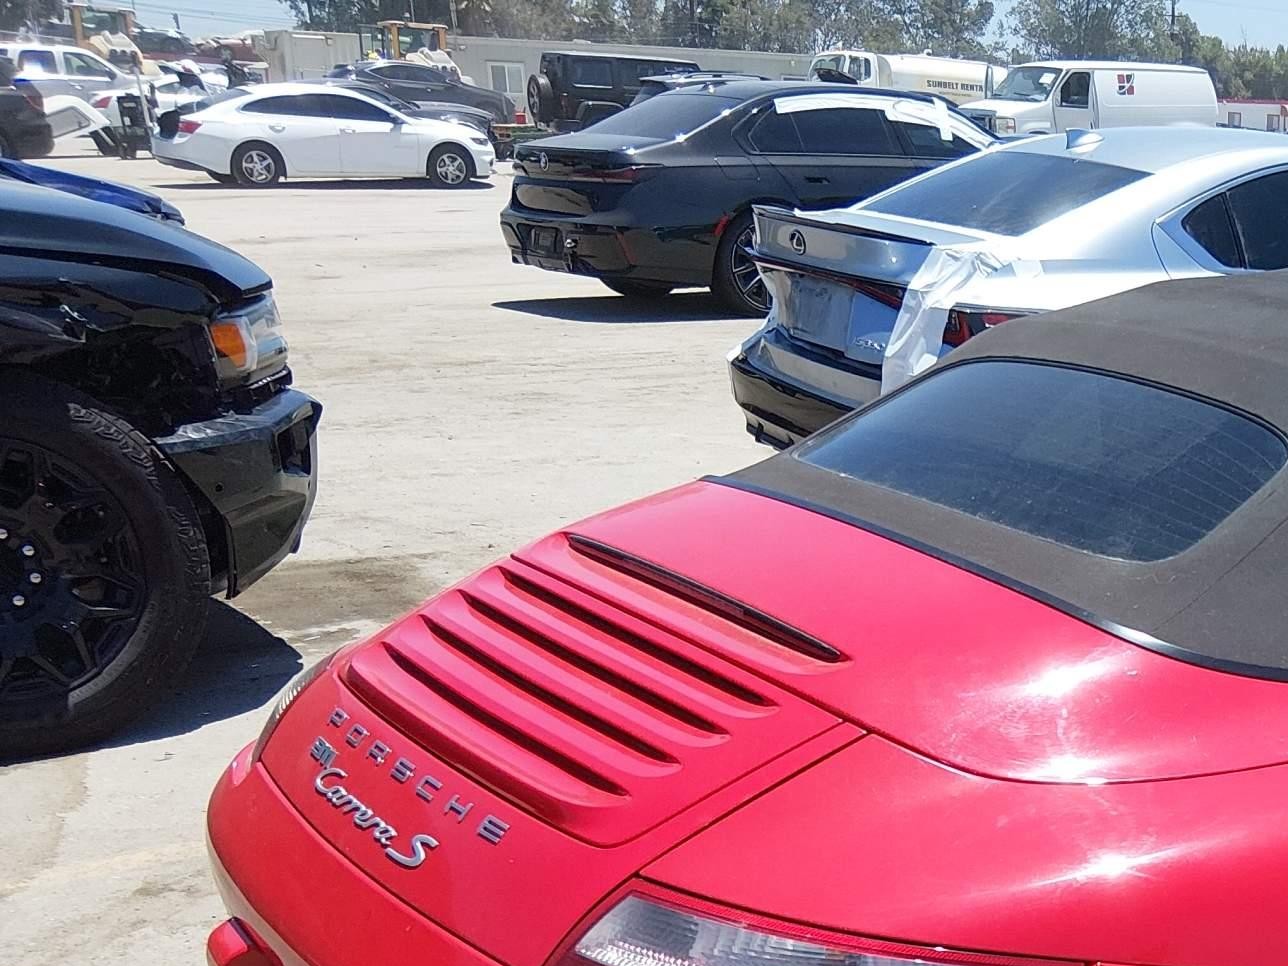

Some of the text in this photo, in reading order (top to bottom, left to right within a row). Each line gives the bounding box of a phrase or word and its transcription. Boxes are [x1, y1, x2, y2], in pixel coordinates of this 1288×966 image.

[926, 79, 984, 93] SUNBELT RENTA
[314, 766, 441, 869] Carrera S
[326, 706, 511, 845] PORSCHE
